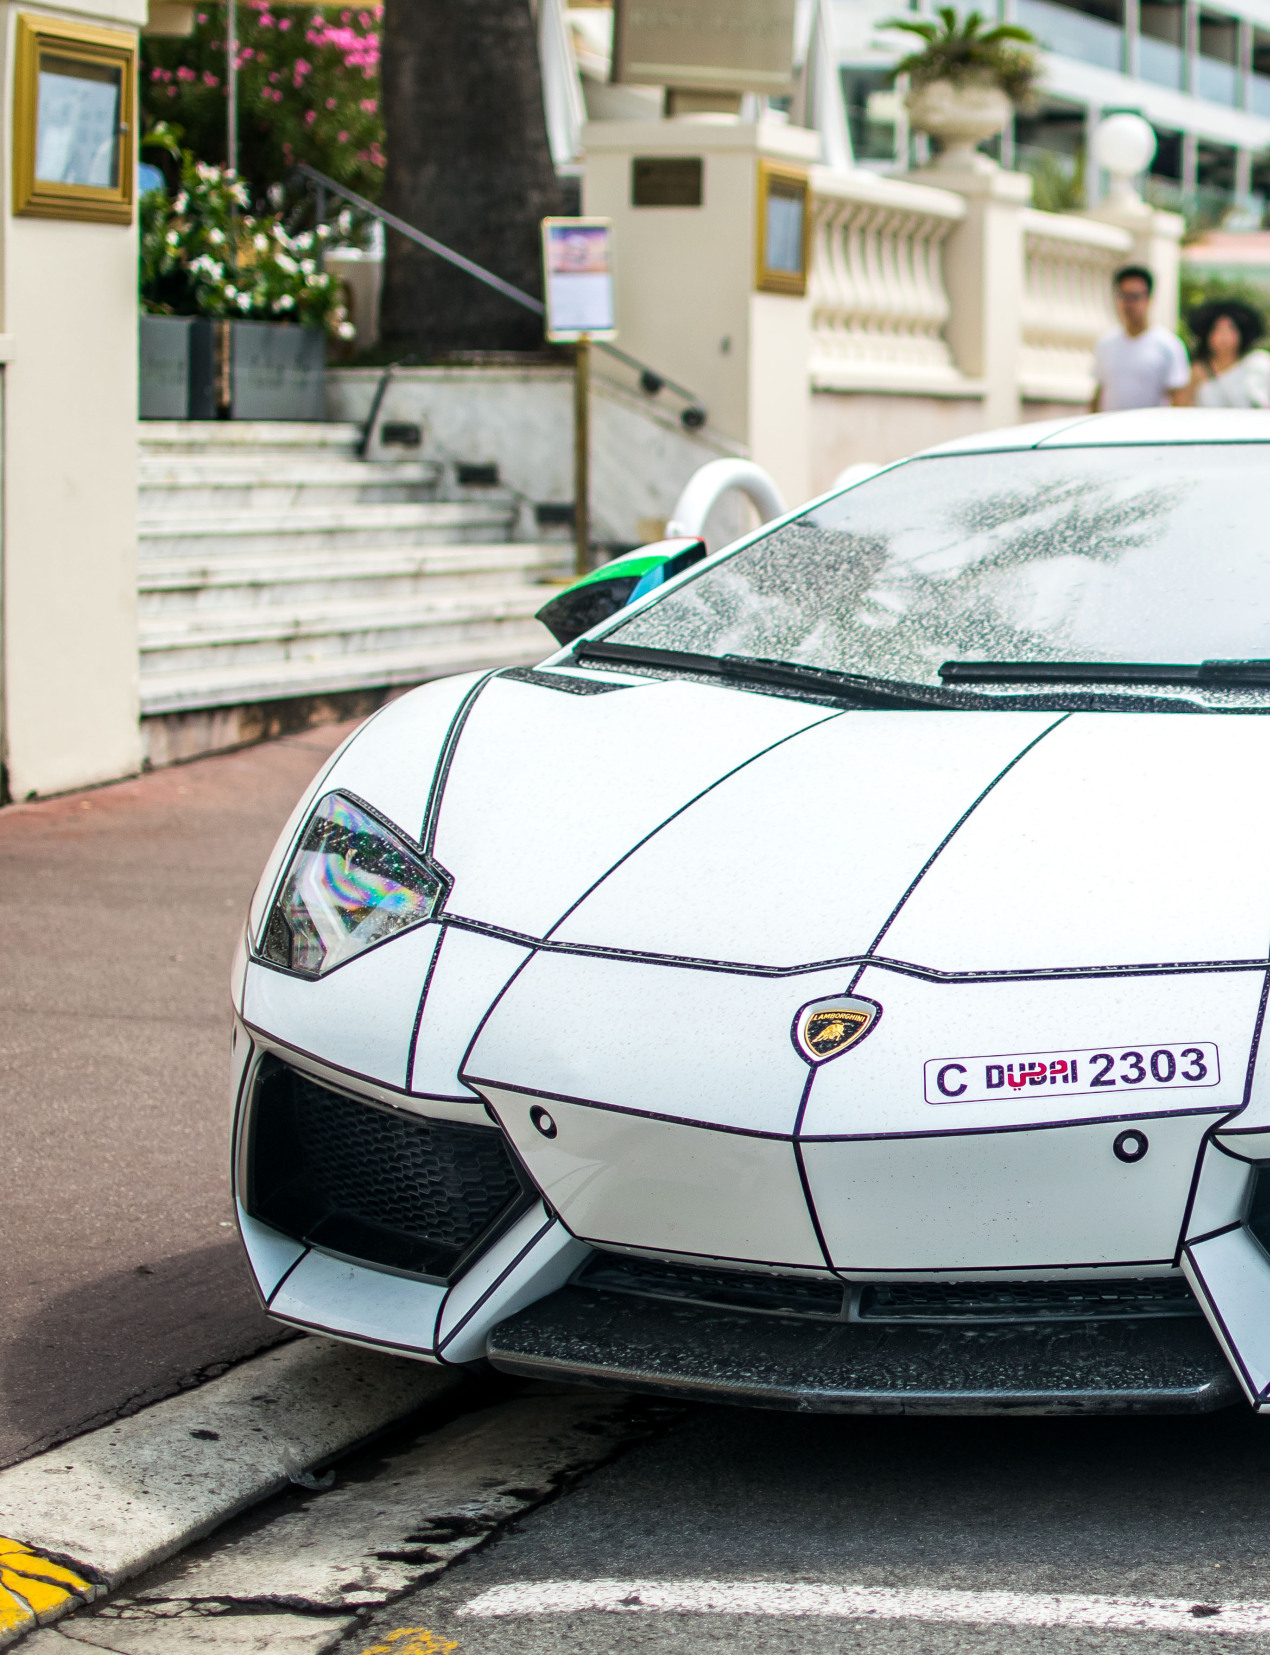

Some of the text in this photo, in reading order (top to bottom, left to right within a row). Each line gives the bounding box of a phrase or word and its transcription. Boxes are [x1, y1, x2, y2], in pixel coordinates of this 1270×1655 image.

[812, 1013, 866, 1023] LAMBORGHINI
[936, 1048, 1208, 1097] C DUBAI 2303
